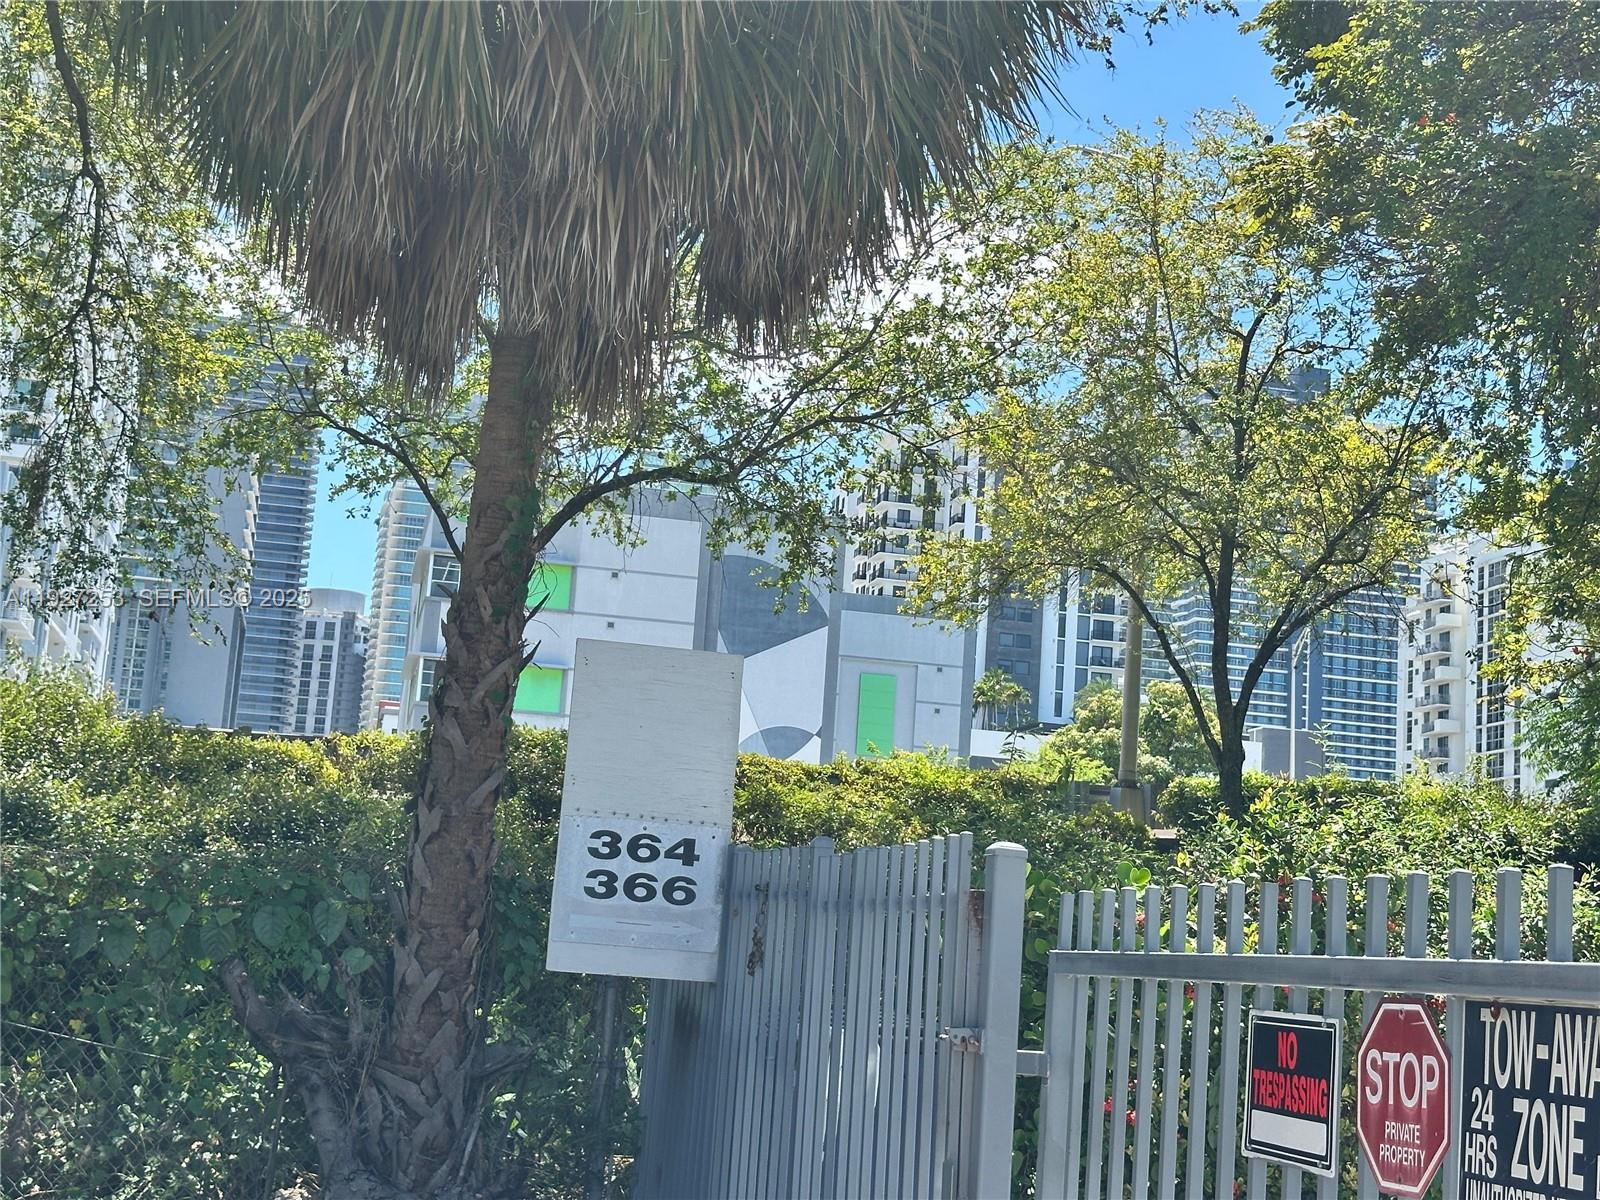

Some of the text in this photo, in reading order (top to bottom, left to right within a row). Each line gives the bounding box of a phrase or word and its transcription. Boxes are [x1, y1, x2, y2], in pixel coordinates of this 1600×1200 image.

[587, 829, 700, 867] 364
[584, 869, 698, 906] 366
[1276, 1031, 1298, 1070] NO
[1253, 1068, 1328, 1118] TRESPASSING
[1365, 1048, 1440, 1109] STOP
[1470, 1086, 1494, 1131] 24
[1385, 1121, 1420, 1144] PRIVATE
[1511, 1097, 1586, 1191] ZONE
[1379, 1143, 1425, 1168] PROPERTY
[1464, 1131, 1498, 1179] HRS
